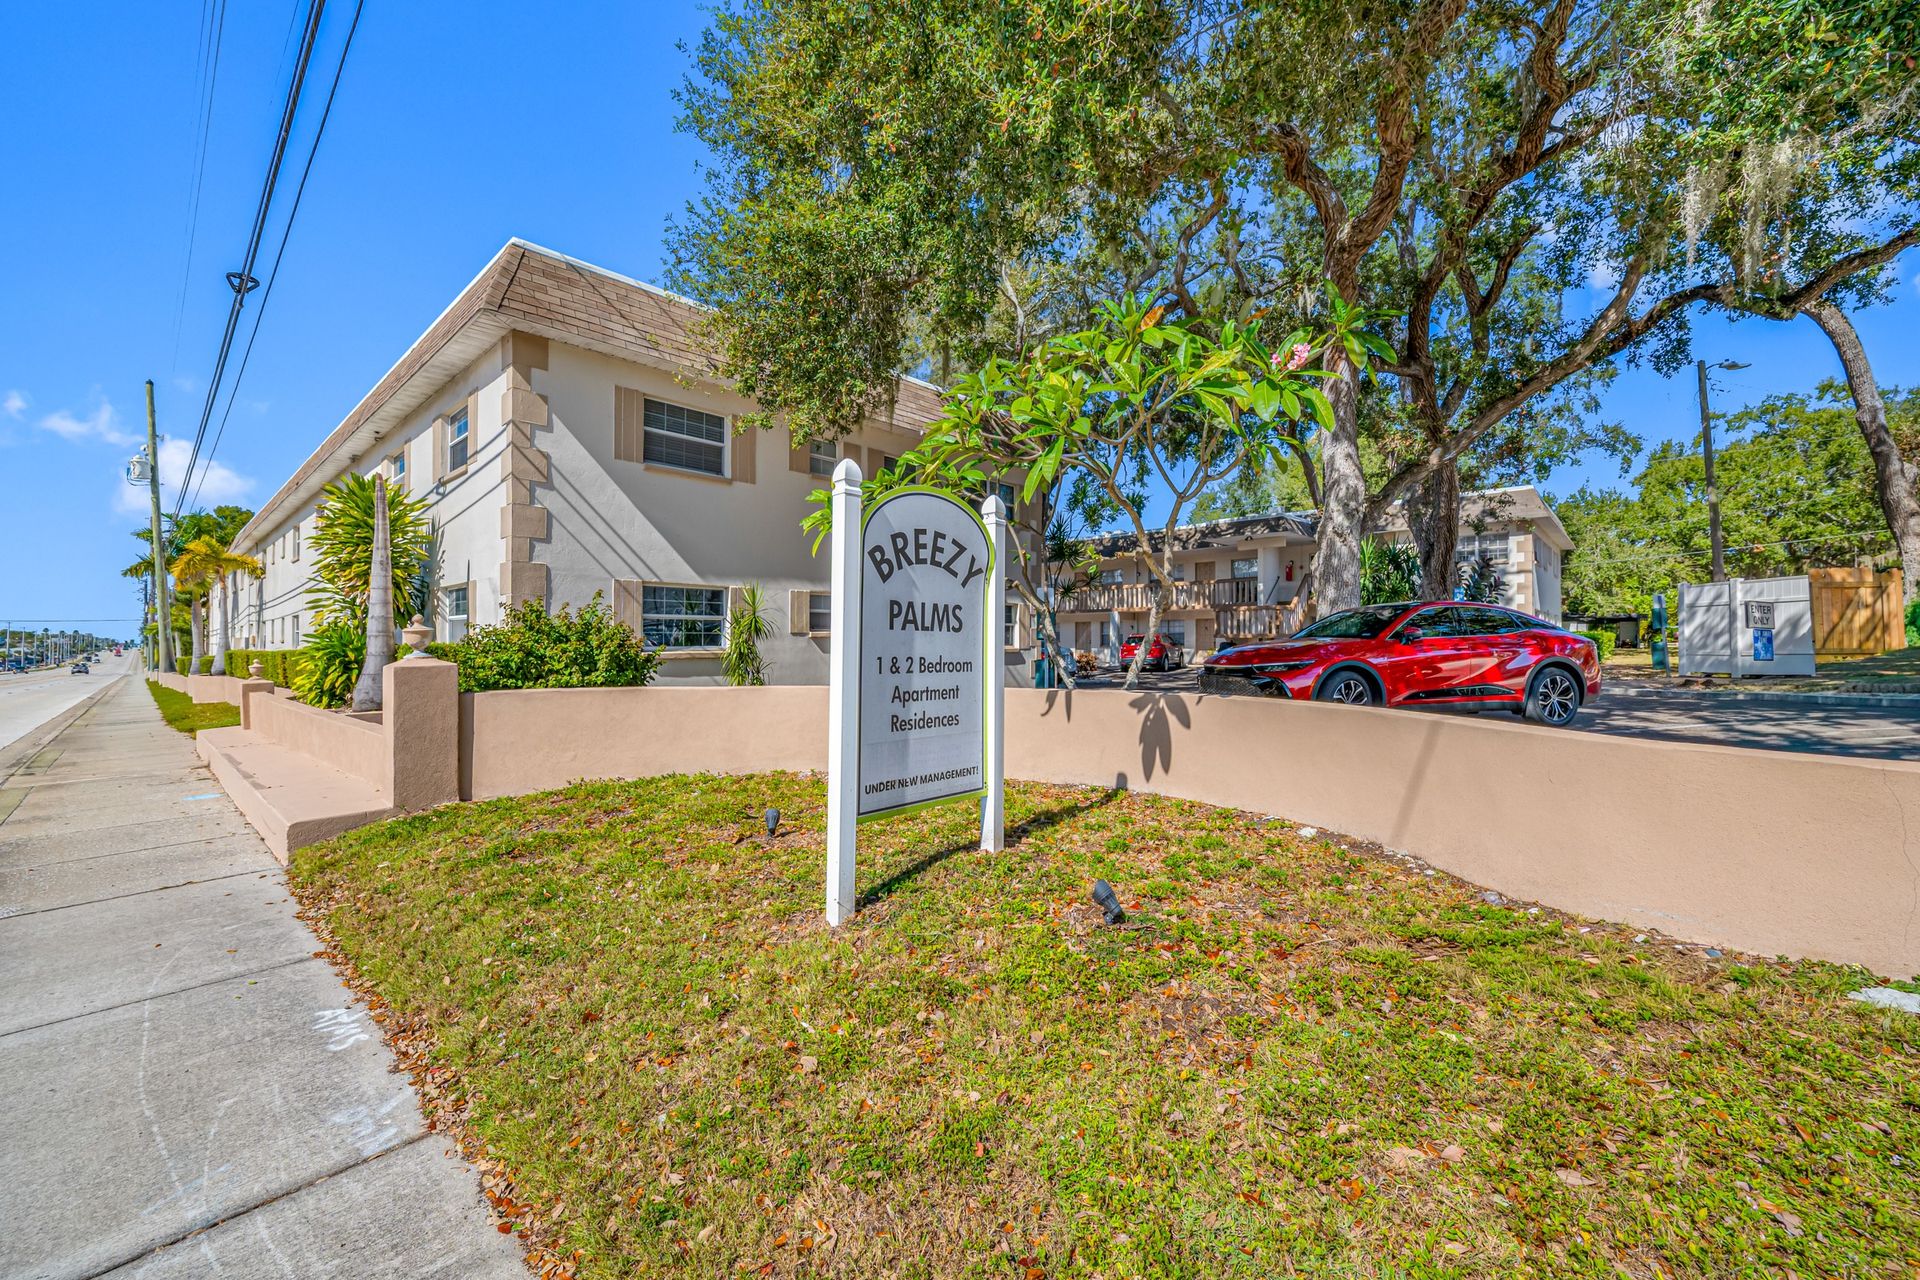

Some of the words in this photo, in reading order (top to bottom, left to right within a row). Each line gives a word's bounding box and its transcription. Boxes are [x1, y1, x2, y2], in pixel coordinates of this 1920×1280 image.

[867, 528, 984, 589] BREEZY
[889, 599, 963, 633] PALMS
[1751, 604, 1771, 614] ENTER
[1753, 615, 1770, 625] ONLY
[876, 656, 883, 675] 1
[890, 656, 901, 675] &
[905, 656, 914, 674] 2
[919, 655, 973, 674] Bedroom
[891, 685, 960, 708] Apartment
[890, 710, 960, 733] Residences
[865, 780, 897, 795] UNDER
[897, 775, 920, 789] NEW
[919, 765, 979, 785] MANAGEMENT!
